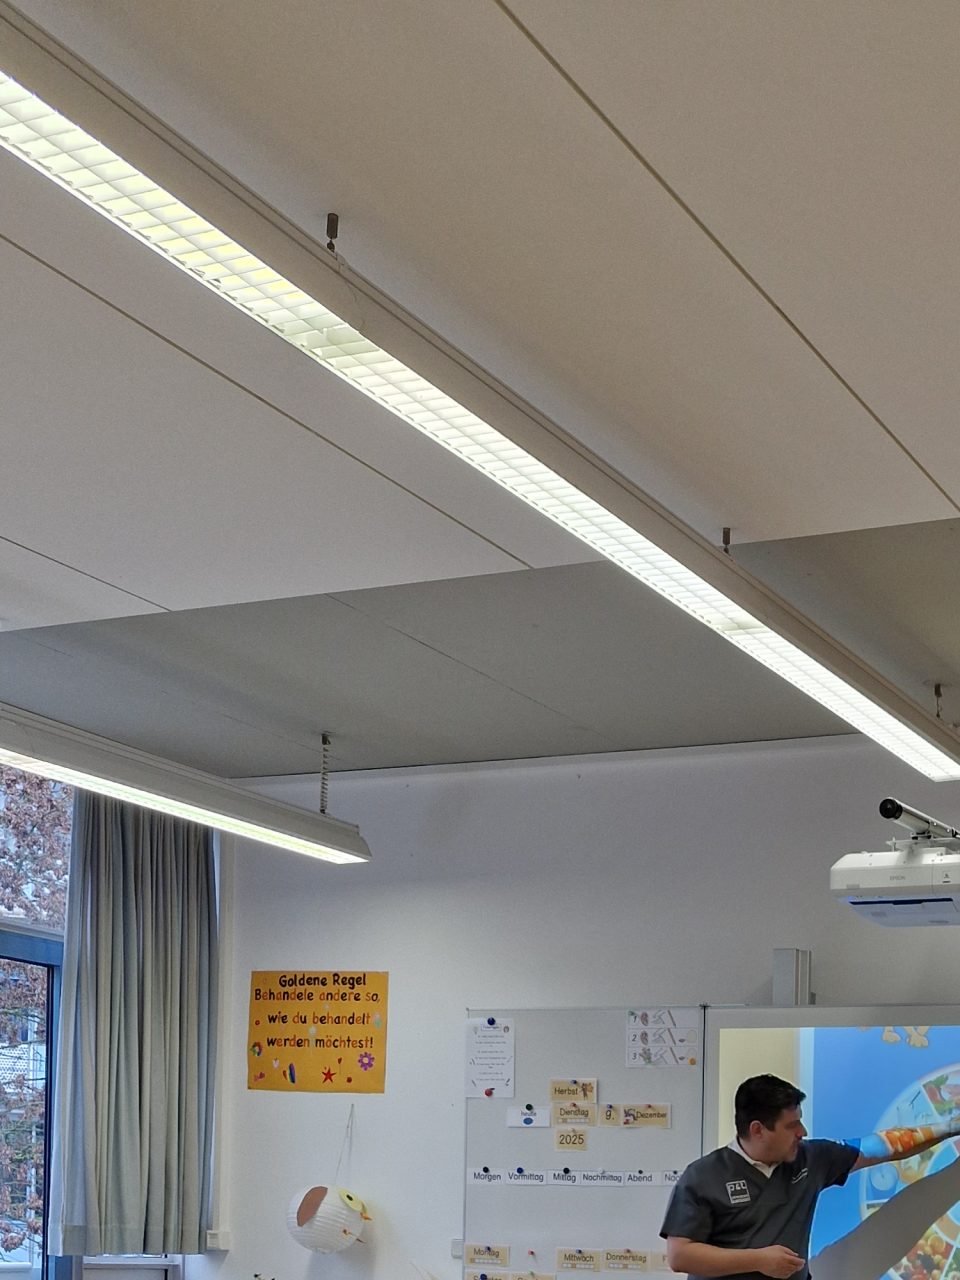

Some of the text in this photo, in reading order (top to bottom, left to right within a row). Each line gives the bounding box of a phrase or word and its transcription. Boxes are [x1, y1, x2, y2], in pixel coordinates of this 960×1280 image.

[279, 973, 366, 990] Goldene Regel
[254, 988, 314, 1001] Behandele
[319, 989, 361, 1001] andere
[268, 1011, 371, 1025] wie du behandelt
[267, 1035, 374, 1048] werden möchtest!
[631, 1034, 637, 1042] 2
[632, 1052, 637, 1060] 3
[554, 1087, 578, 1096] Herbst
[559, 1107, 589, 1118] Dienstag
[605, 1110, 615, 1120] 9.
[636, 1111, 667, 1119] Dezember
[559, 1134, 585, 1145] 2025
[473, 1172, 502, 1183] Morgen
[508, 1172, 544, 1183] Vormittag
[552, 1173, 577, 1184] Mittag
[582, 1173, 623, 1183] Nachmittag
[627, 1174, 653, 1182] Abend
[473, 1248, 500, 1258] Montag
[564, 1253, 594, 1262] Mittwoch
[606, 1252, 647, 1263] Donnerstag
